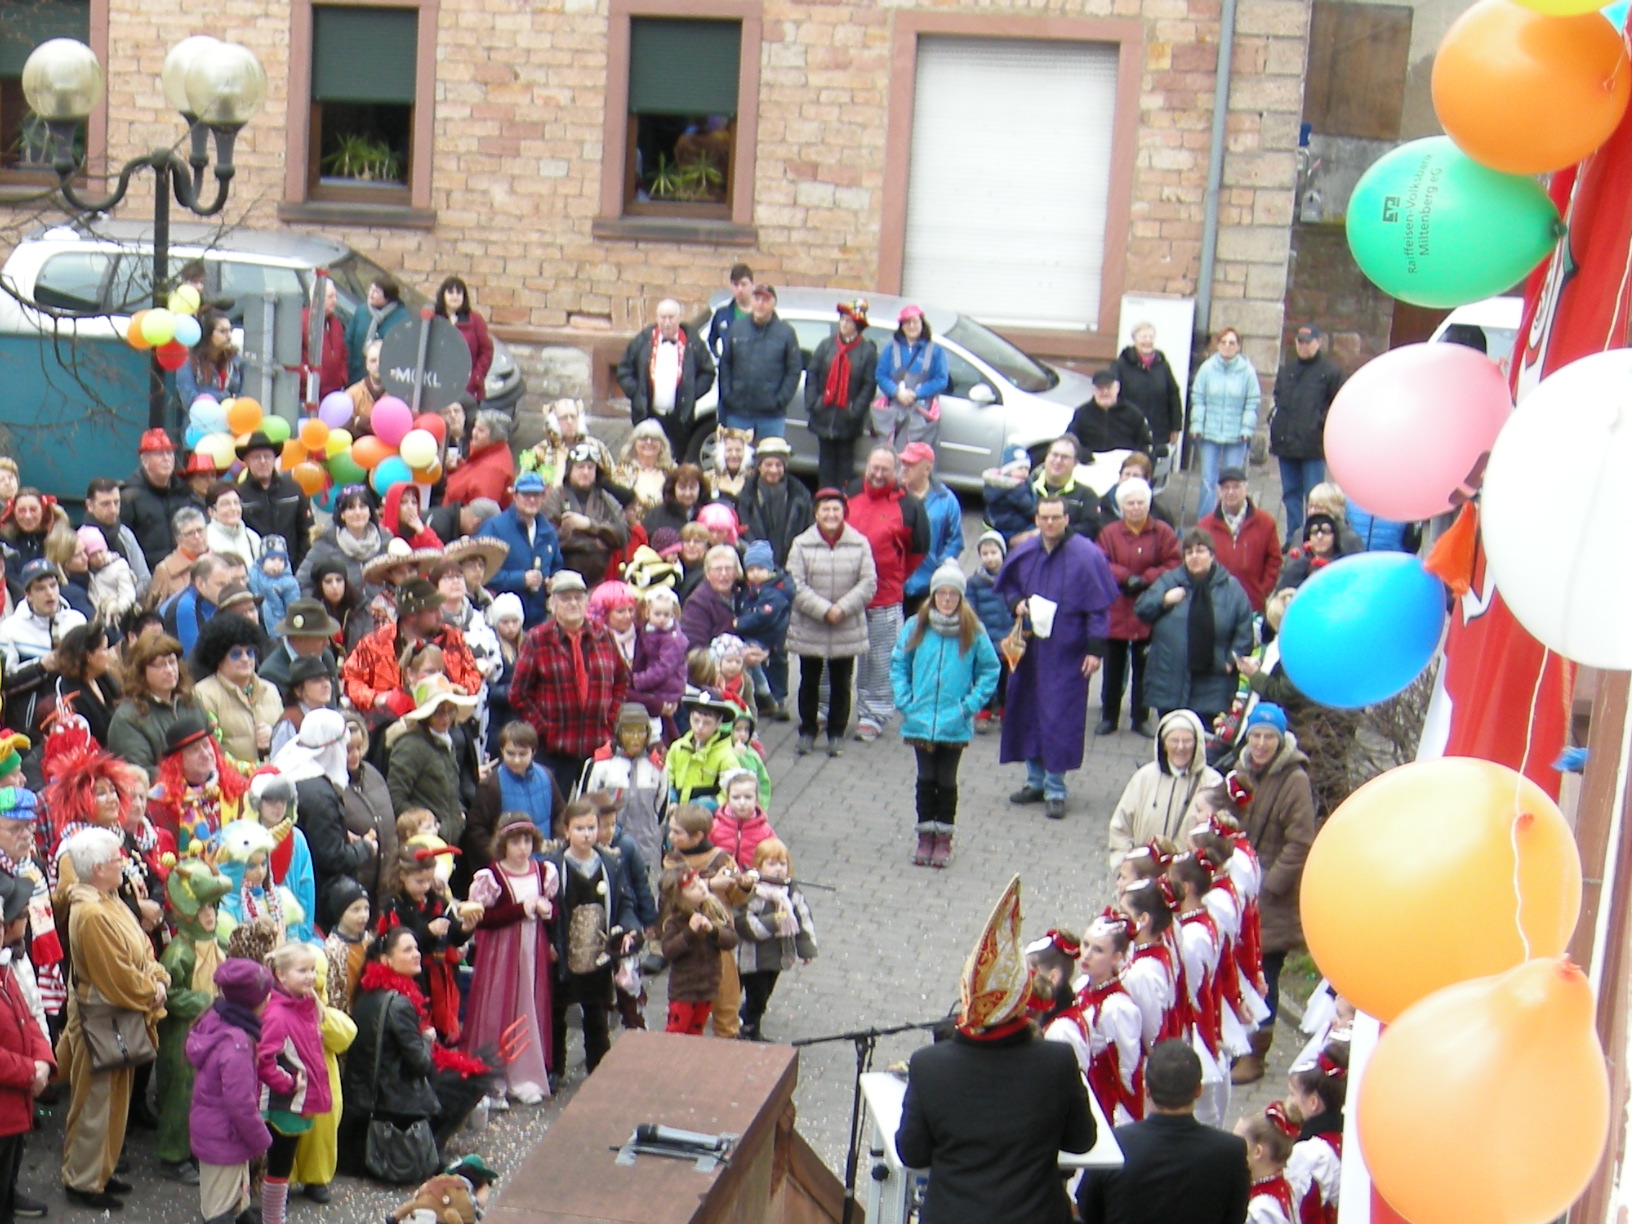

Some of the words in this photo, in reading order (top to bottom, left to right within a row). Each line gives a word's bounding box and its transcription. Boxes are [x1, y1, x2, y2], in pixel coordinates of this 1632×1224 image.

[1403, 153, 1432, 274] Raiffeisen-Volksbank
[1418, 185, 1439, 256] Miltenberg
[1430, 167, 1443, 184] eG
